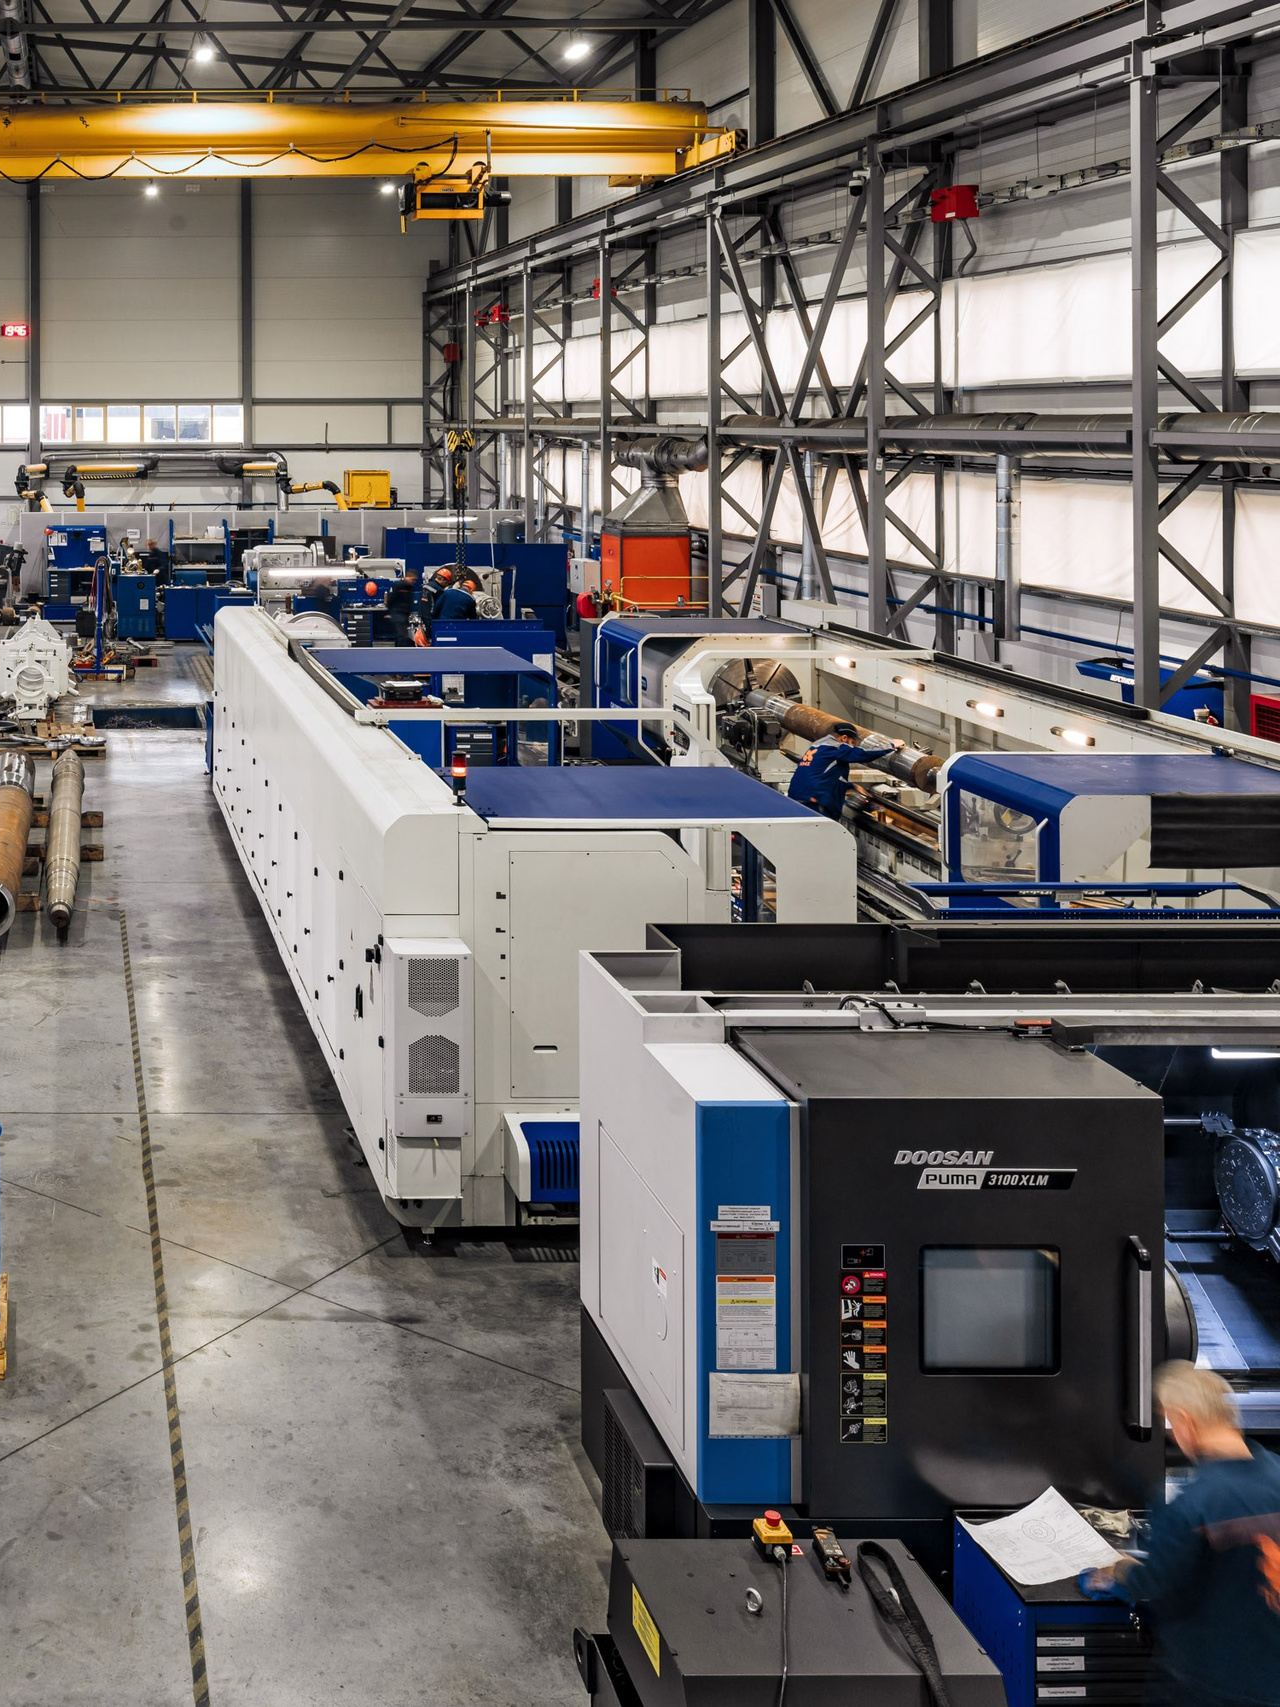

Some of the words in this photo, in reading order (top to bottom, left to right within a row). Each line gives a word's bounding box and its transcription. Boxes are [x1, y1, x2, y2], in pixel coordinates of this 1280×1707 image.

[894, 1150, 994, 1166] DOOSAN
[926, 1174, 977, 1185] PUMA
[988, 1174, 1050, 1186] 3100XLM
